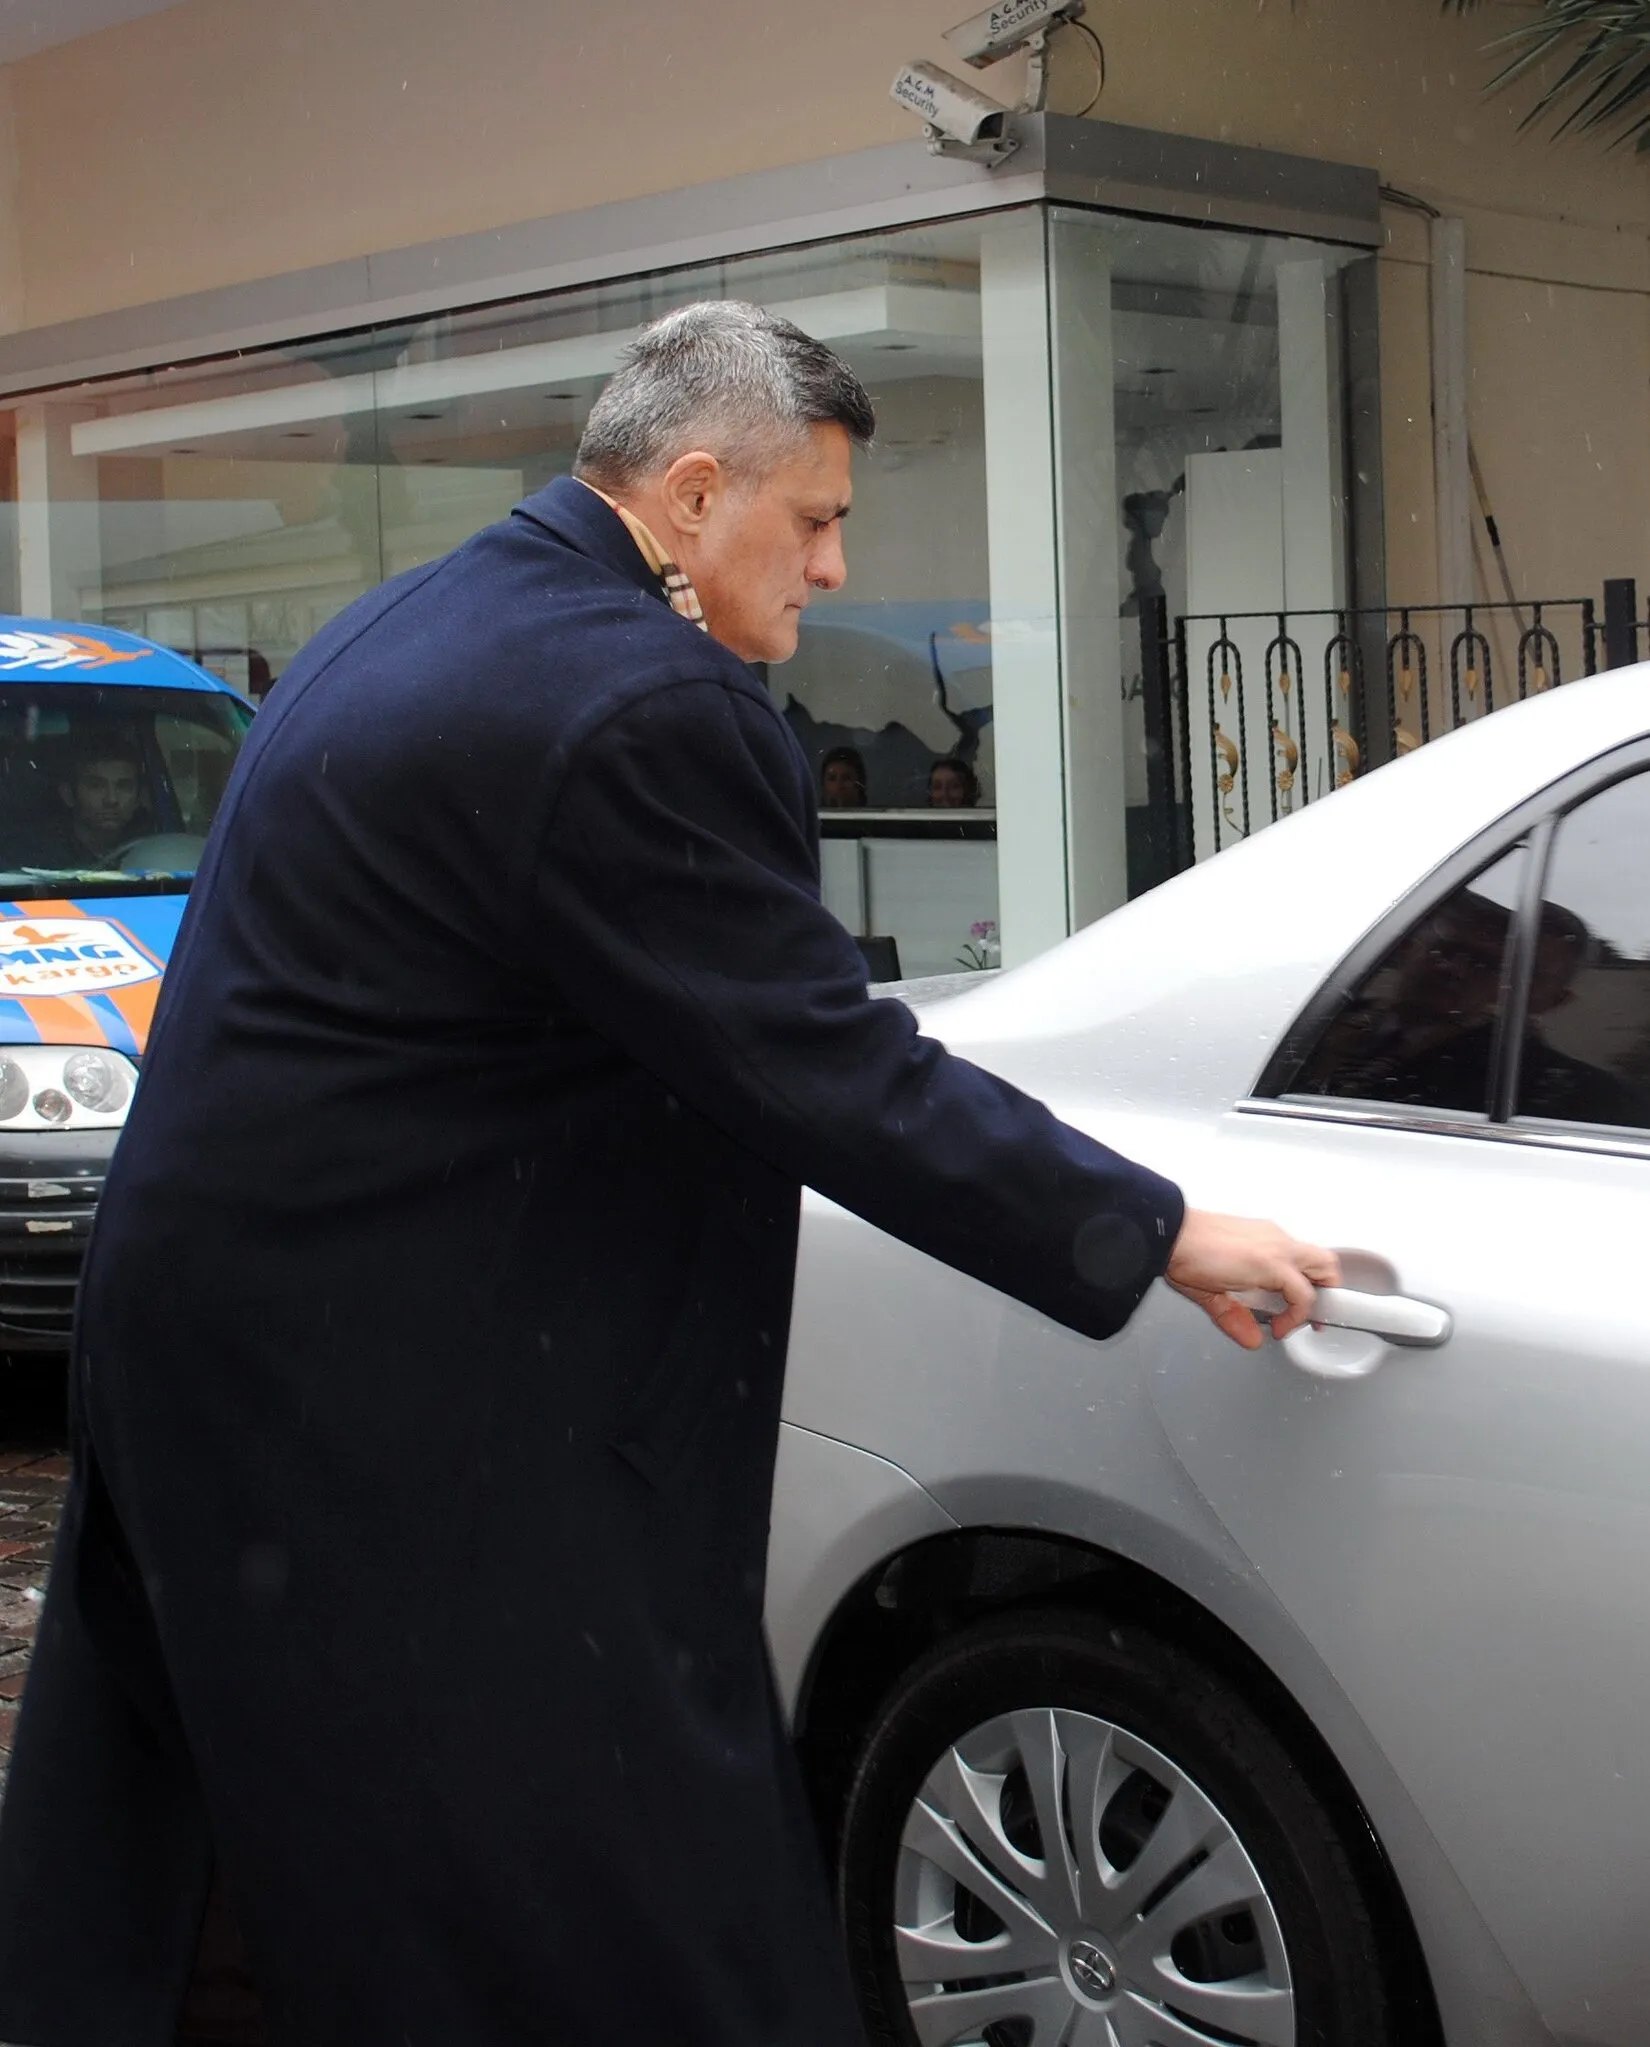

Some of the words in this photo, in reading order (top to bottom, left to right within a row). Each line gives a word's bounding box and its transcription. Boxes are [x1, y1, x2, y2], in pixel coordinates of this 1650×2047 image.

[990, 0, 1048, 35] Security
[895, 81, 939, 118] Security
[0, 944, 124, 968] MNG
